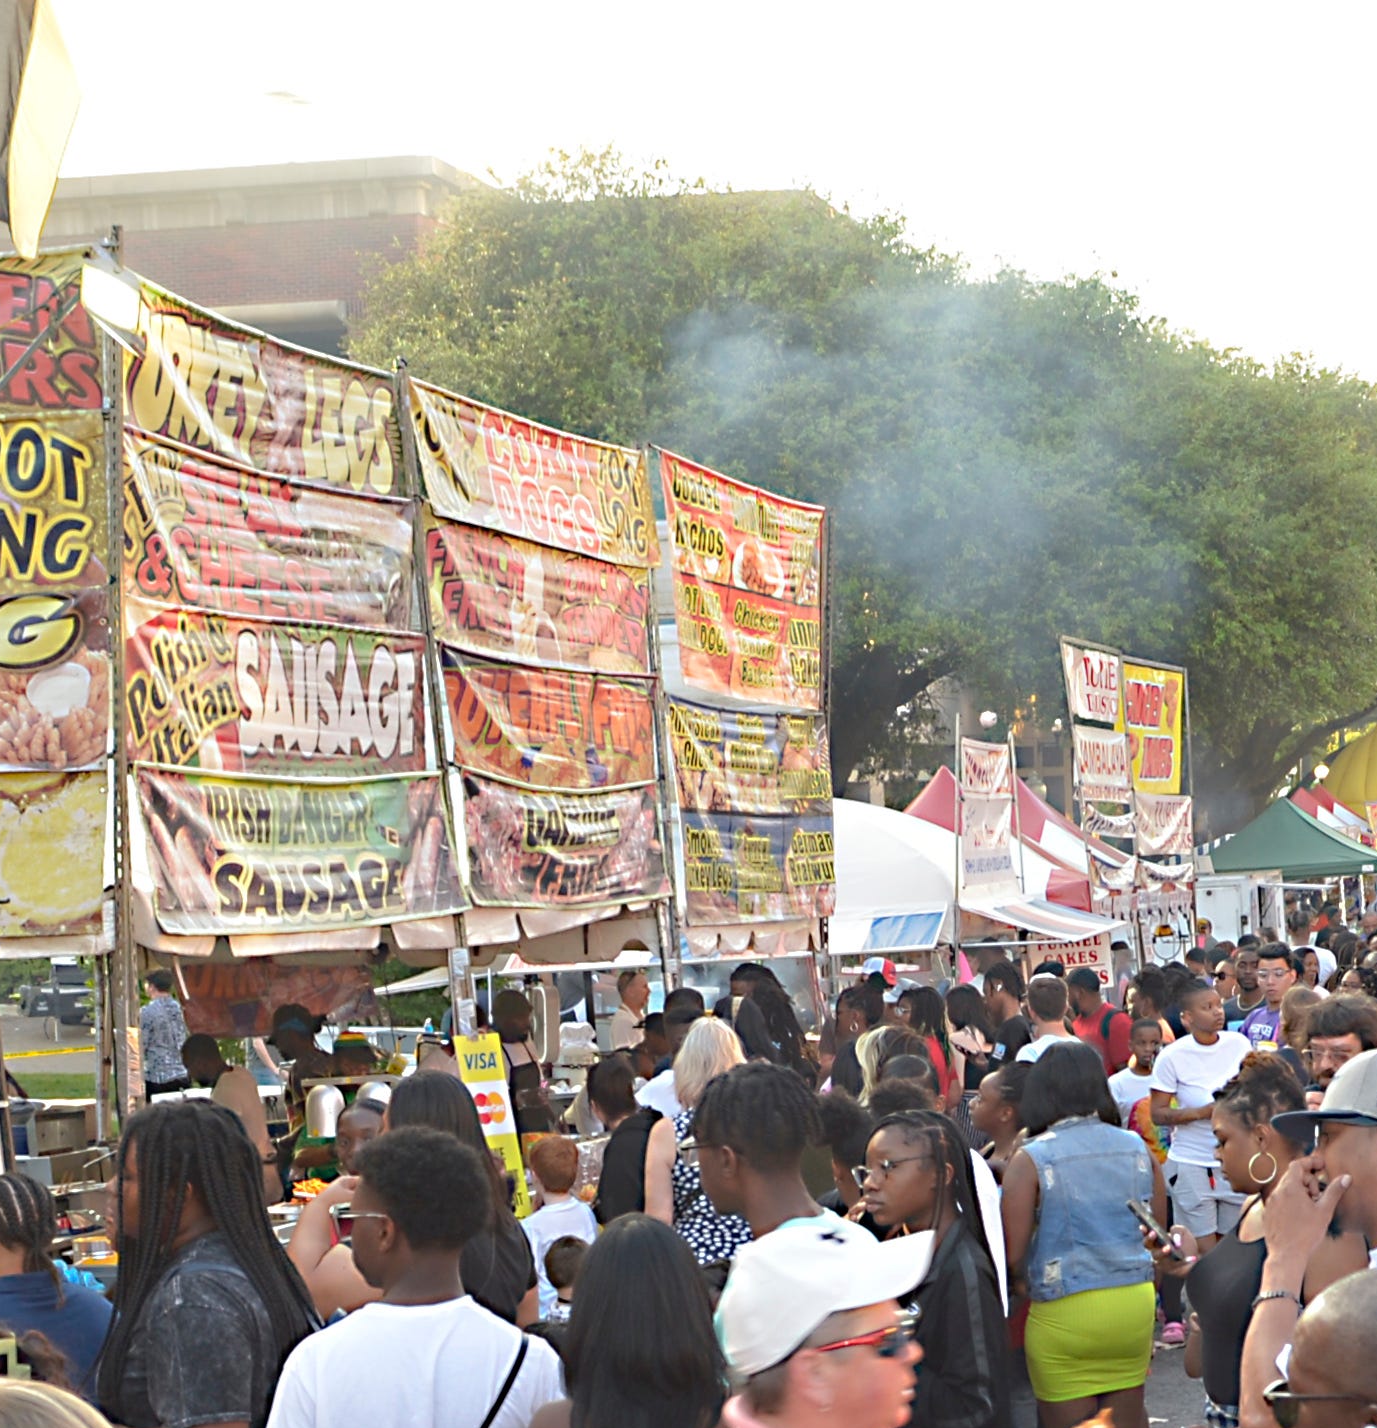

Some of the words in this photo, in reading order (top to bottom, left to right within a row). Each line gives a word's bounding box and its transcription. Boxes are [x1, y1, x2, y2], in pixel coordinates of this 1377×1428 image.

[299, 367, 395, 496] LEGS
[489, 466, 602, 558] DOGS
[136, 532, 173, 599] &
[125, 612, 207, 749] Polish
[151, 675, 242, 766] Italian
[235, 628, 418, 761] SAUSAGE
[212, 851, 408, 927] SAUSAGE
[1043, 950, 1099, 965] CAKES
[463, 1052, 498, 1071] VISA
